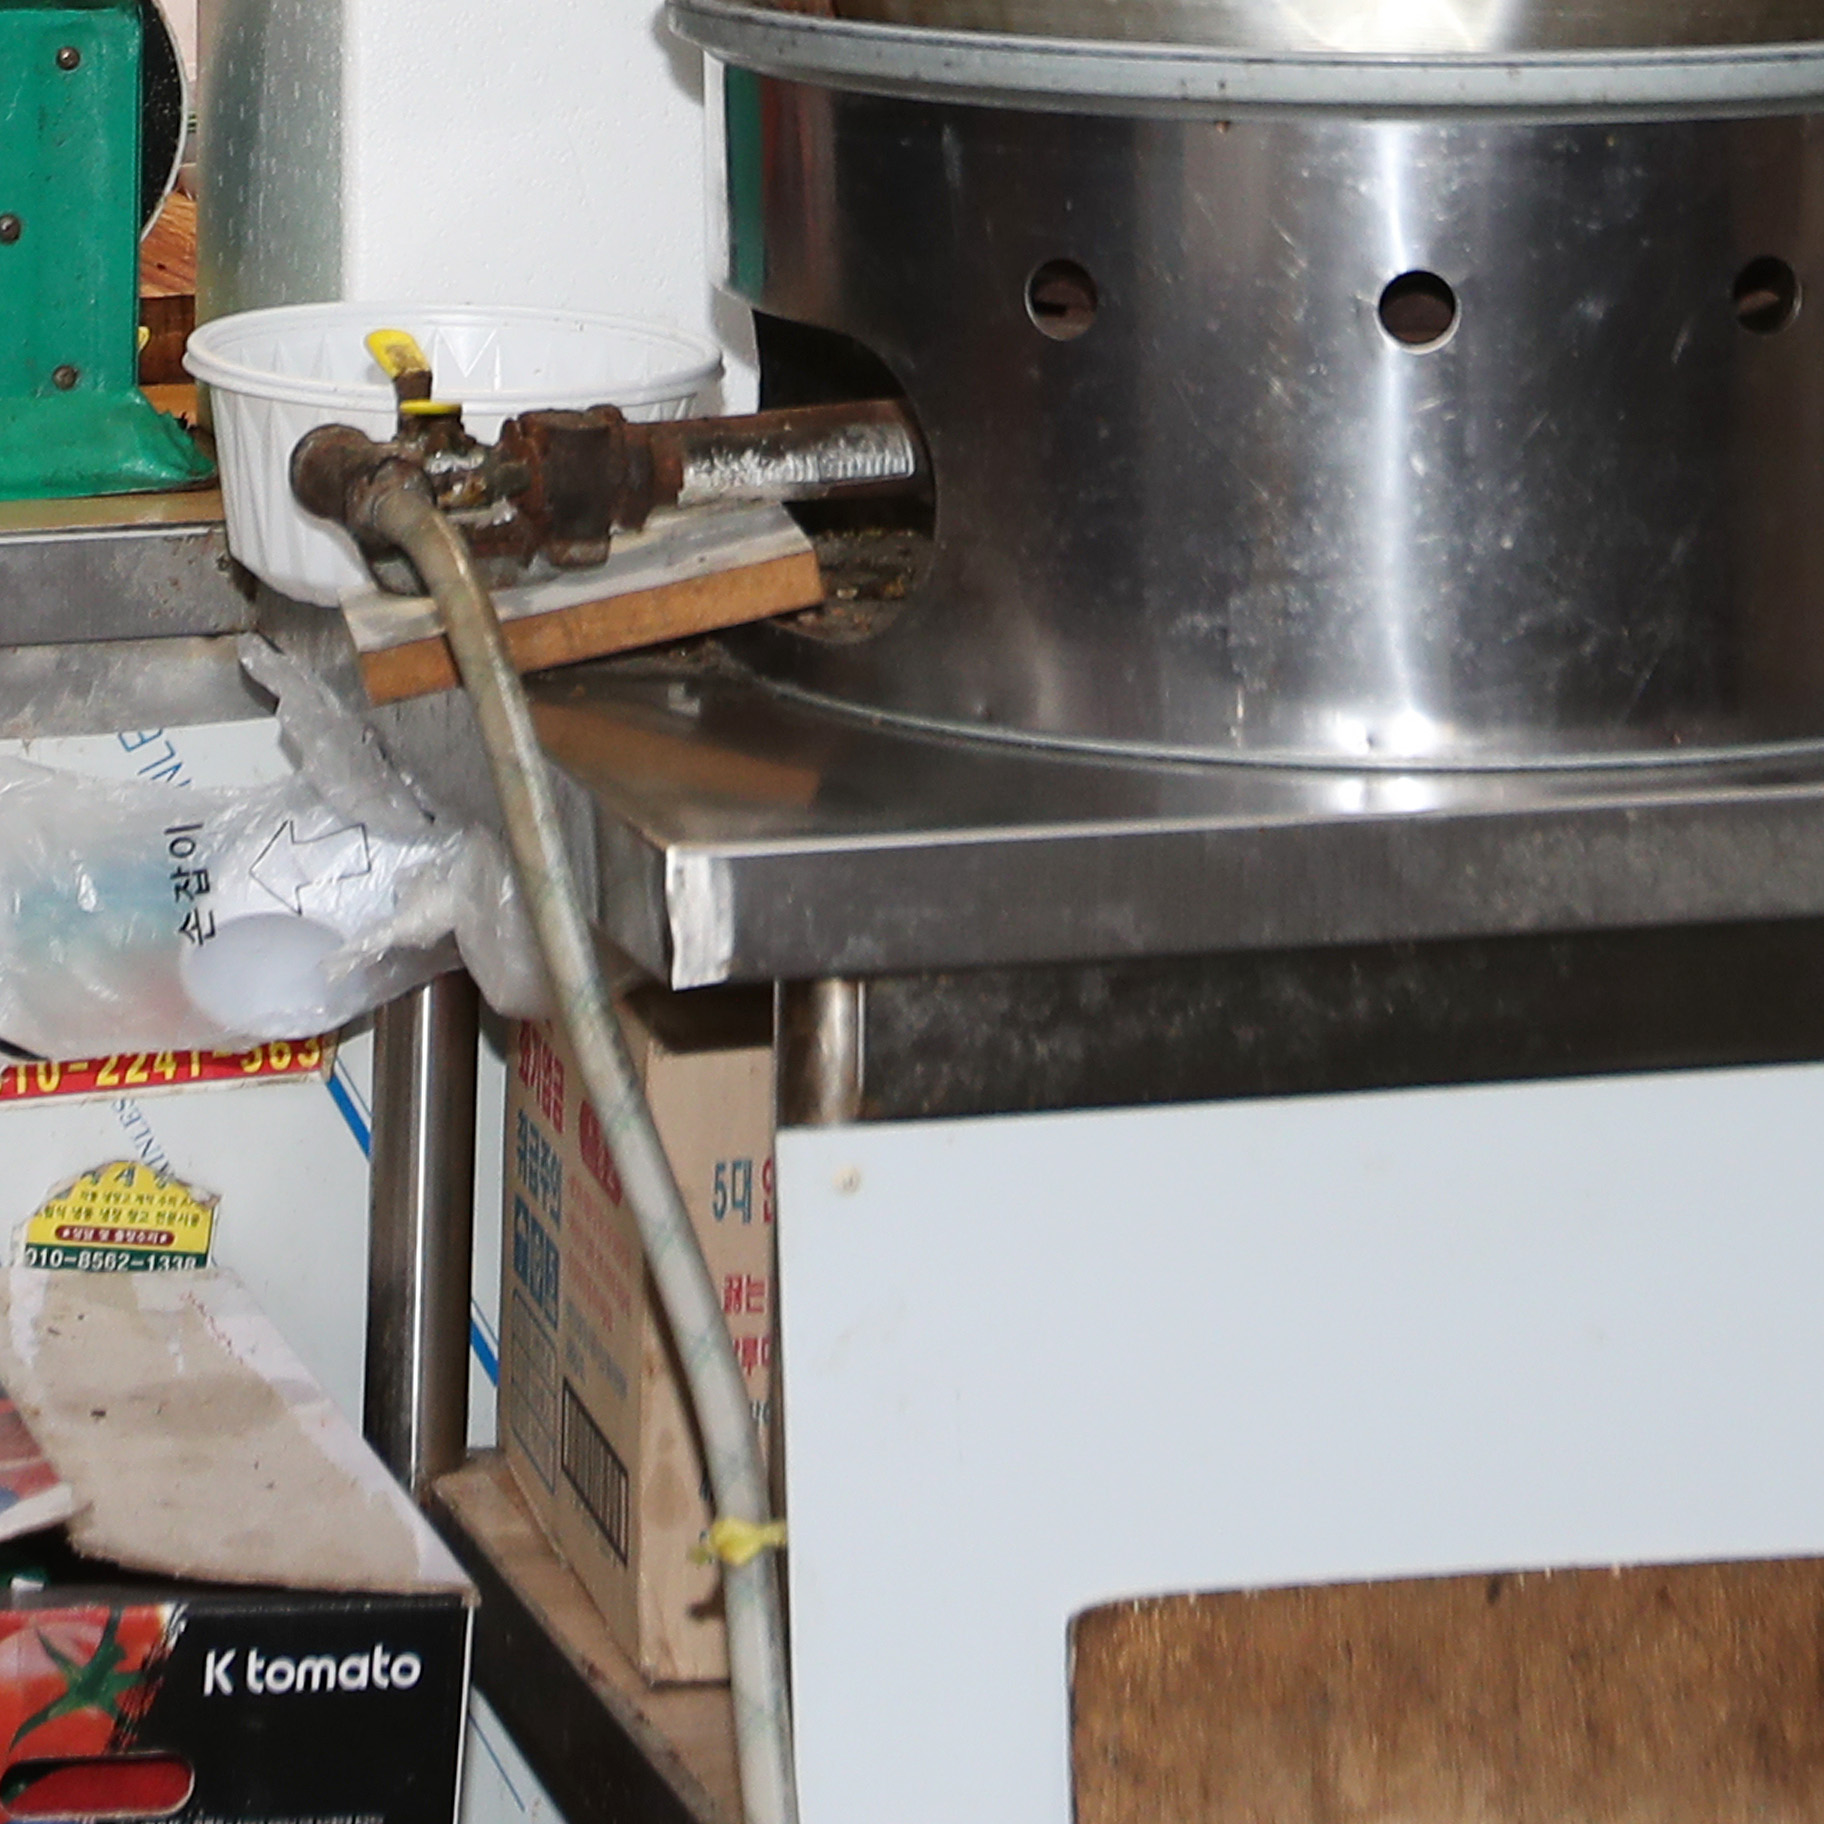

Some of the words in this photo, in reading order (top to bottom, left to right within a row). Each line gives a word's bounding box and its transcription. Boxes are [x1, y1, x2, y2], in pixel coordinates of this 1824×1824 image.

[164, 823, 216, 946] 손잡이
[516, 1108, 563, 1232] 취급주의
[204, 1648, 236, 1696] K
[246, 1643, 422, 1694] tomato
